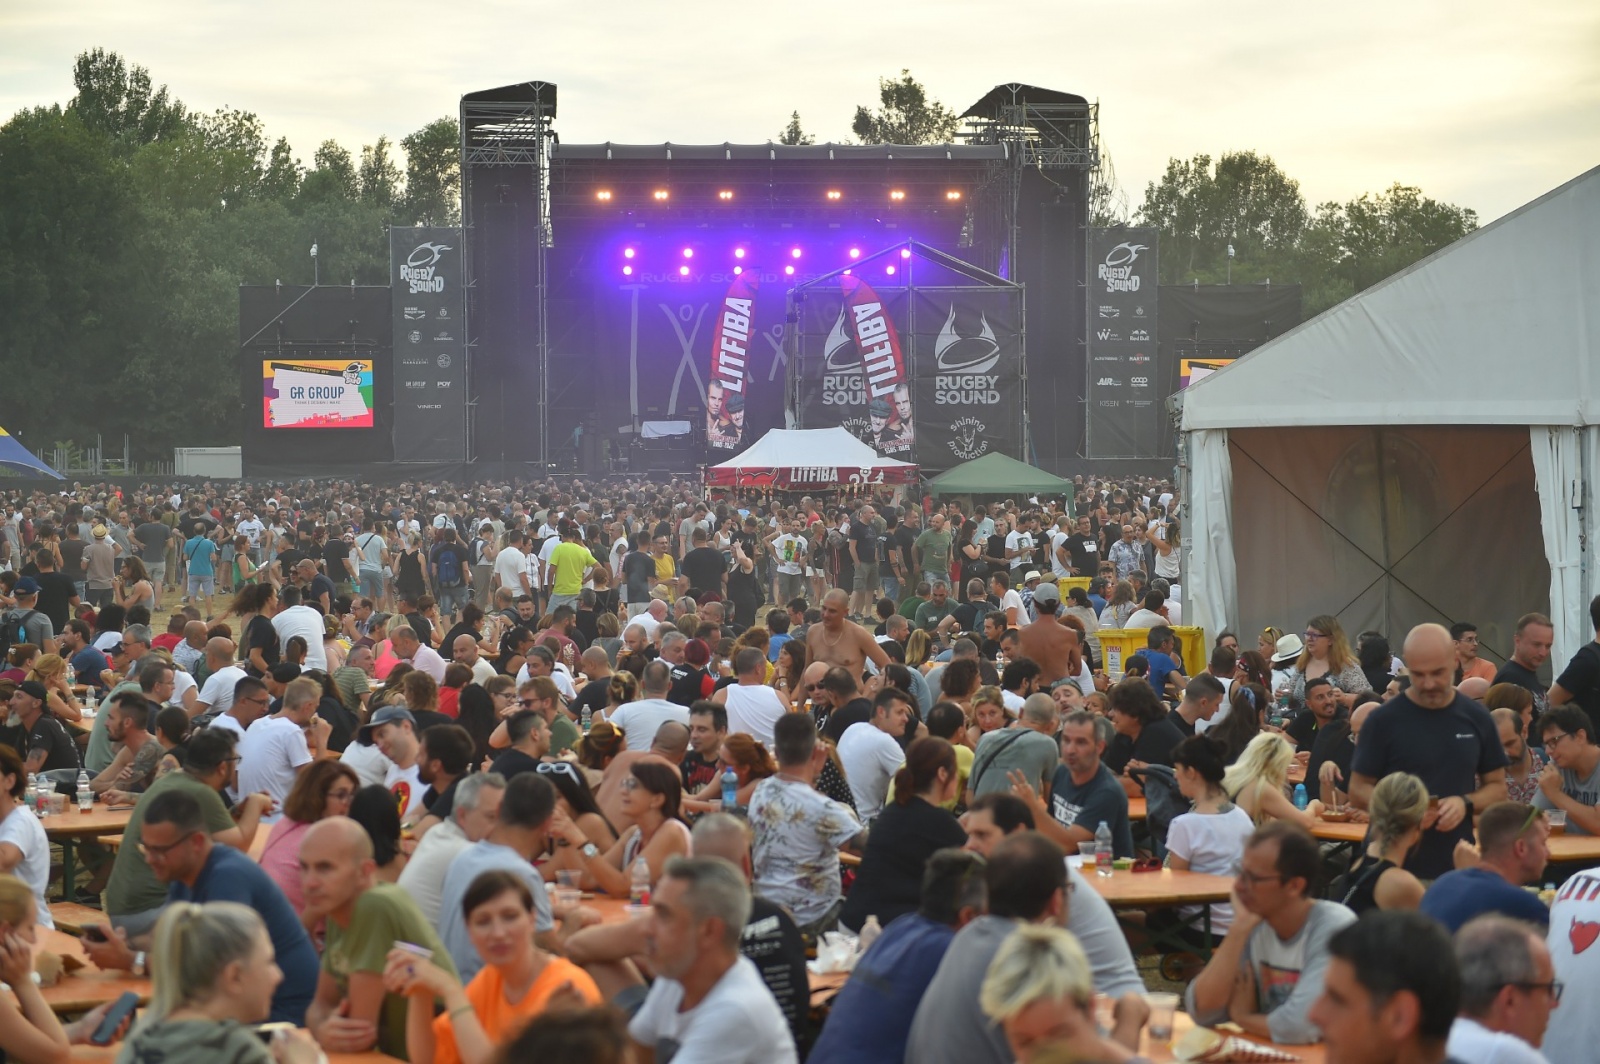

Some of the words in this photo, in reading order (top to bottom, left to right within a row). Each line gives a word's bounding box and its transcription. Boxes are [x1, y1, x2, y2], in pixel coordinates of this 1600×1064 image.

[718, 296, 752, 392] LITFIBA
[935, 376, 999, 390] RUGBY
[290, 387, 304, 399] GR
[309, 387, 345, 399] GROUP
[935, 390, 1000, 405] SOUND
[950, 416, 986, 432] shining
[947, 440, 988, 460] production
[790, 466, 838, 483] LITFIBA
